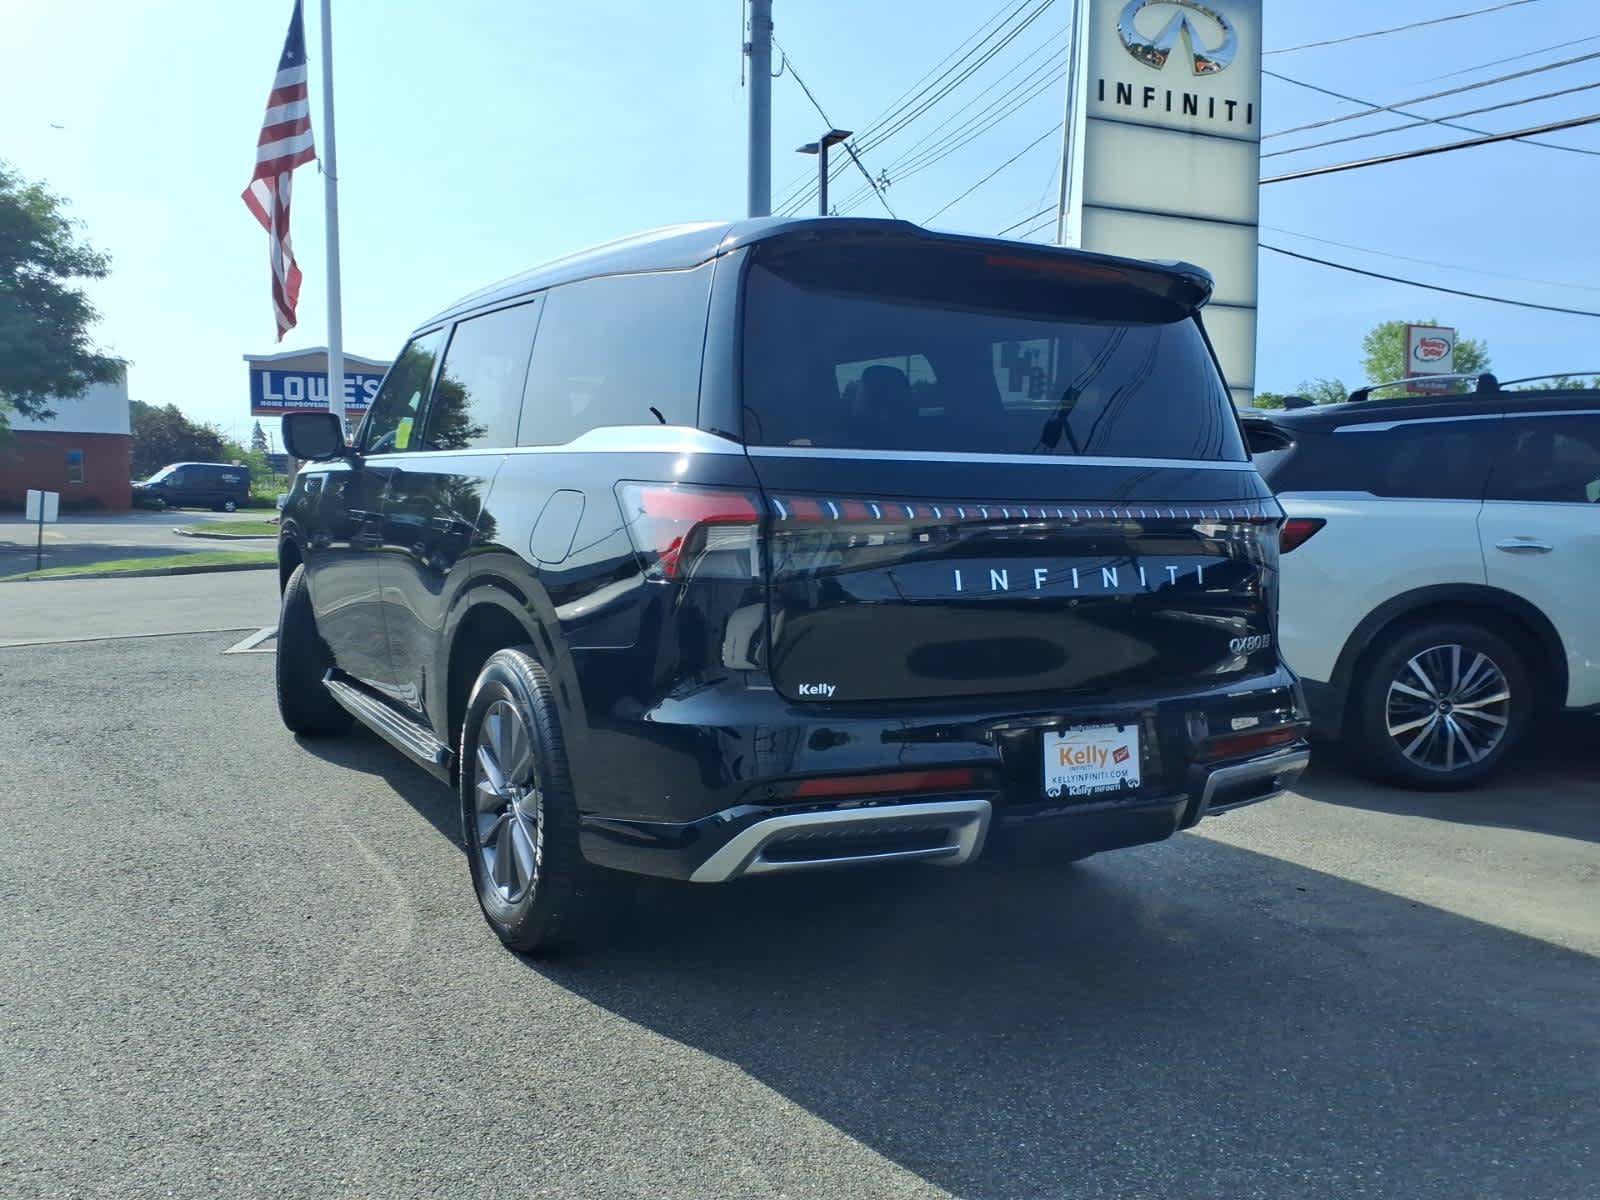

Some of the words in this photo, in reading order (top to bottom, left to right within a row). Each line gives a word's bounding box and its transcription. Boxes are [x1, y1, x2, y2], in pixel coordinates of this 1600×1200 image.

[1098, 79, 1253, 124] INFINITI
[262, 371, 379, 403] LOWE'S
[954, 564, 1204, 592] INFINITI
[1229, 634, 1262, 652] QX80
[799, 683, 836, 697] Kelly
[1060, 745, 1108, 768] Kelly
